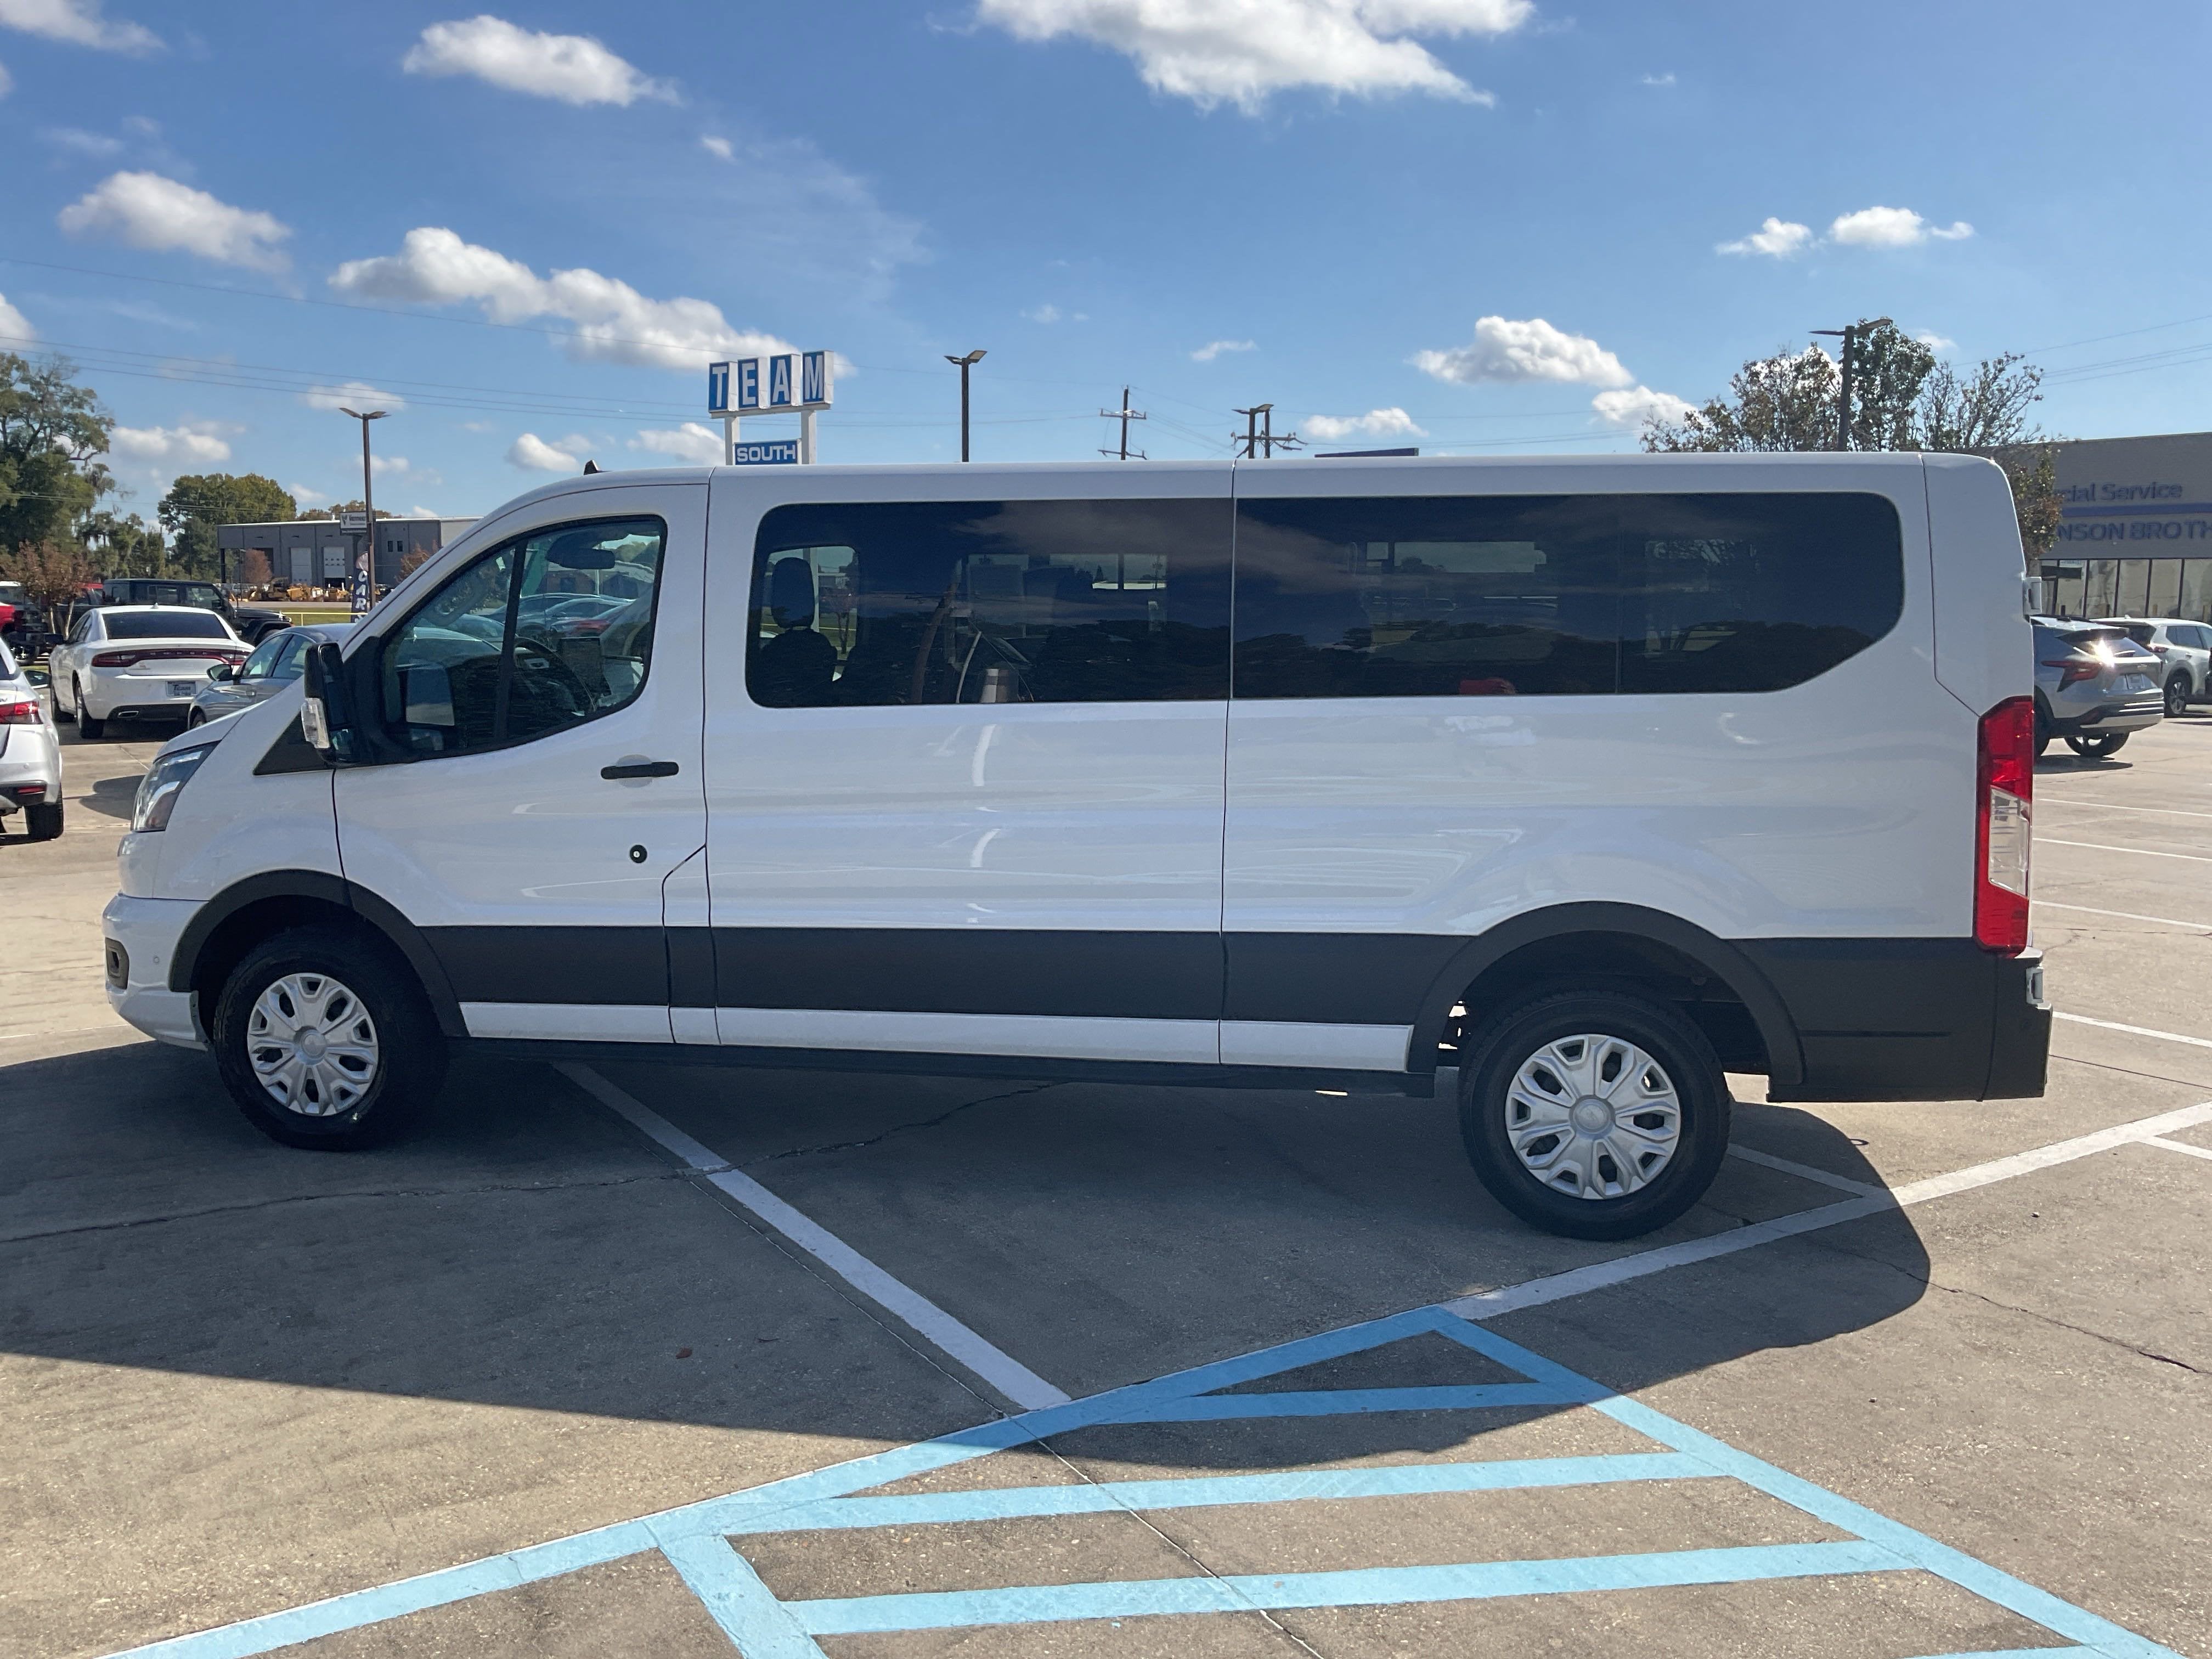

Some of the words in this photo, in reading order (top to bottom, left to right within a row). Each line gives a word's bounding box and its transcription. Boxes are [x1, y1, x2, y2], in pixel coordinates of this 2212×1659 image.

[712, 355, 822, 408] TEAM
[737, 444, 795, 462] SOUTH
[2055, 483, 2096, 501] cial
[2102, 481, 2183, 500] Service
